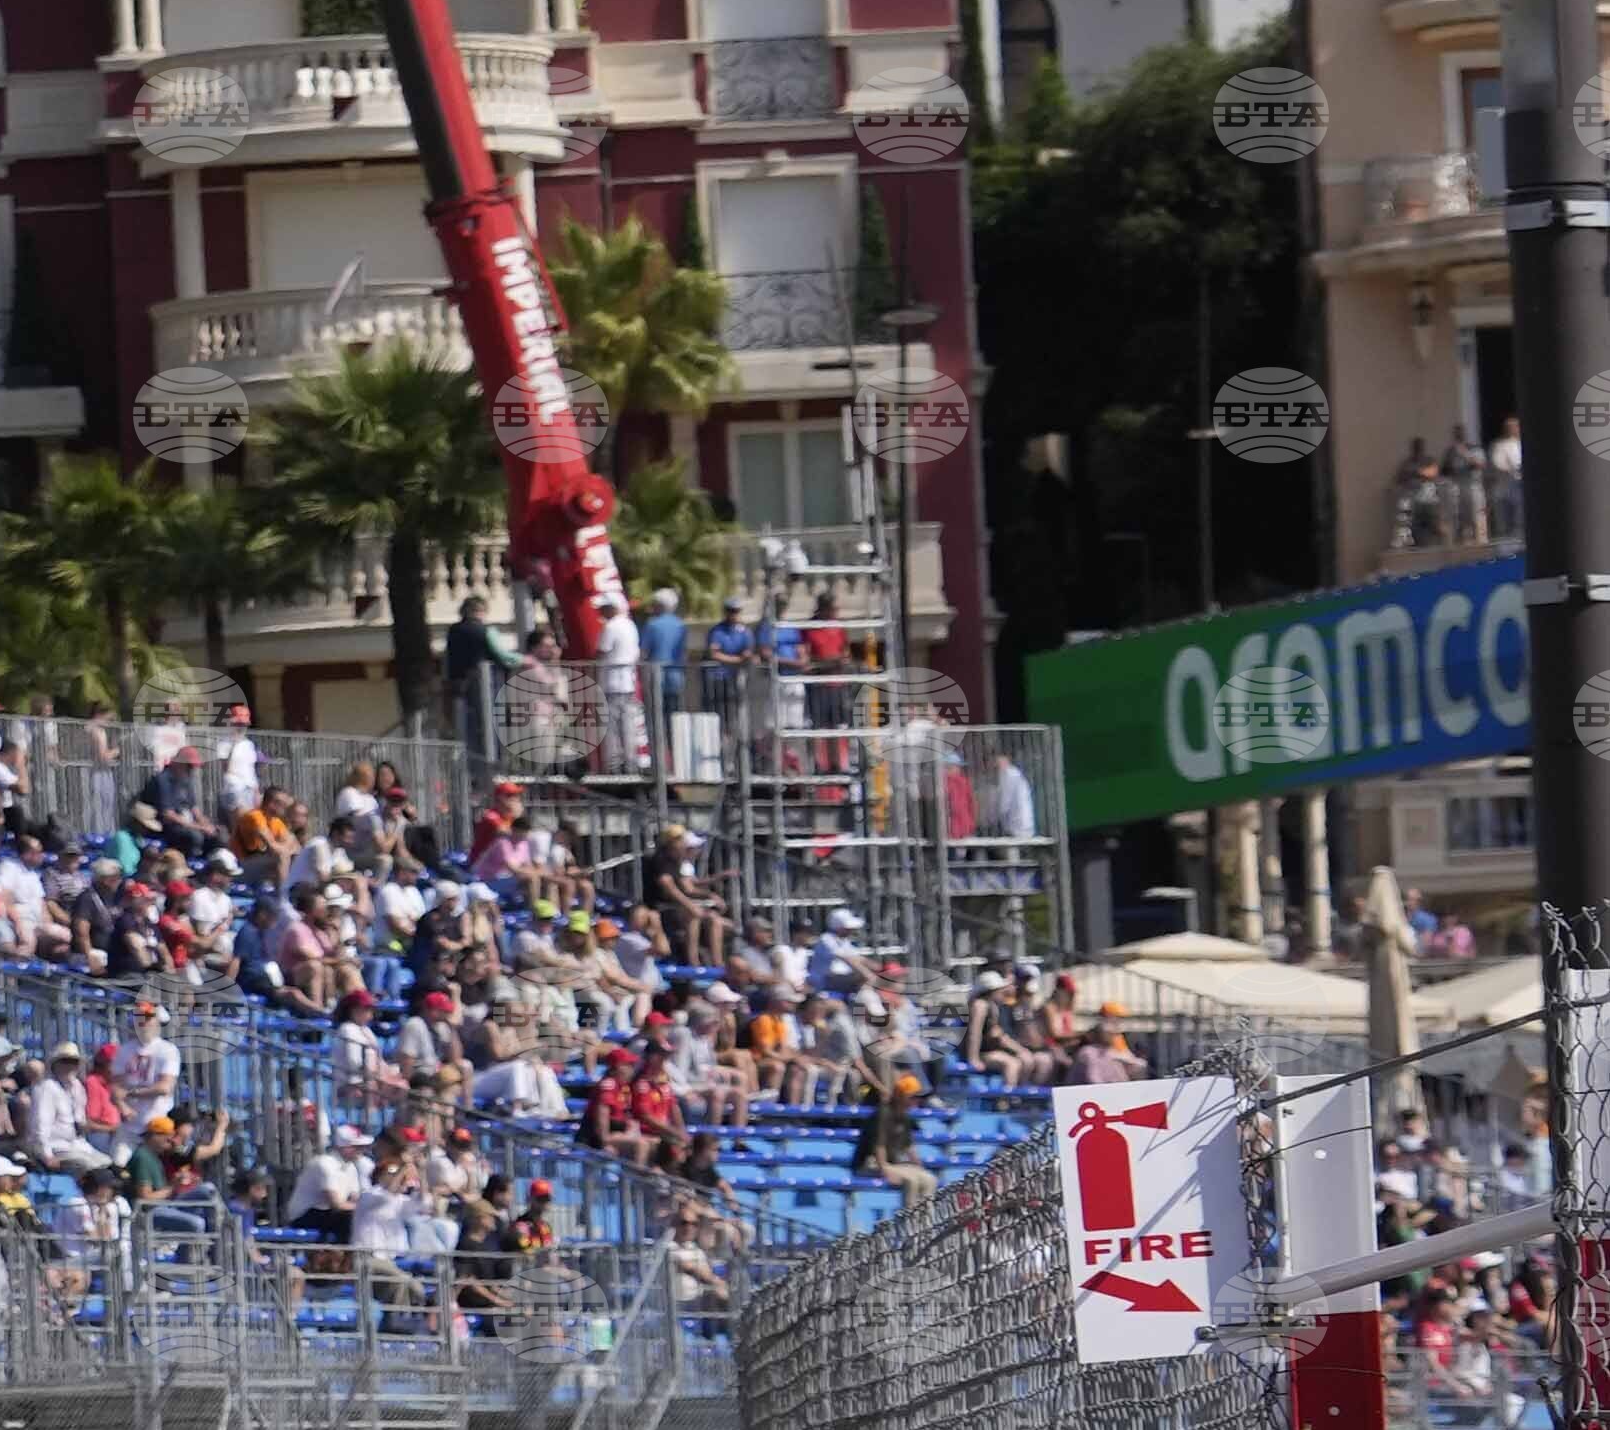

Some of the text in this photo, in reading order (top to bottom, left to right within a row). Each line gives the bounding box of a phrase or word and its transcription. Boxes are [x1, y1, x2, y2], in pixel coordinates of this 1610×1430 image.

[491, 236, 571, 427] IMPERIAL
[1165, 582, 1531, 783] aramco
[1084, 1230, 1215, 1266] FIRE
